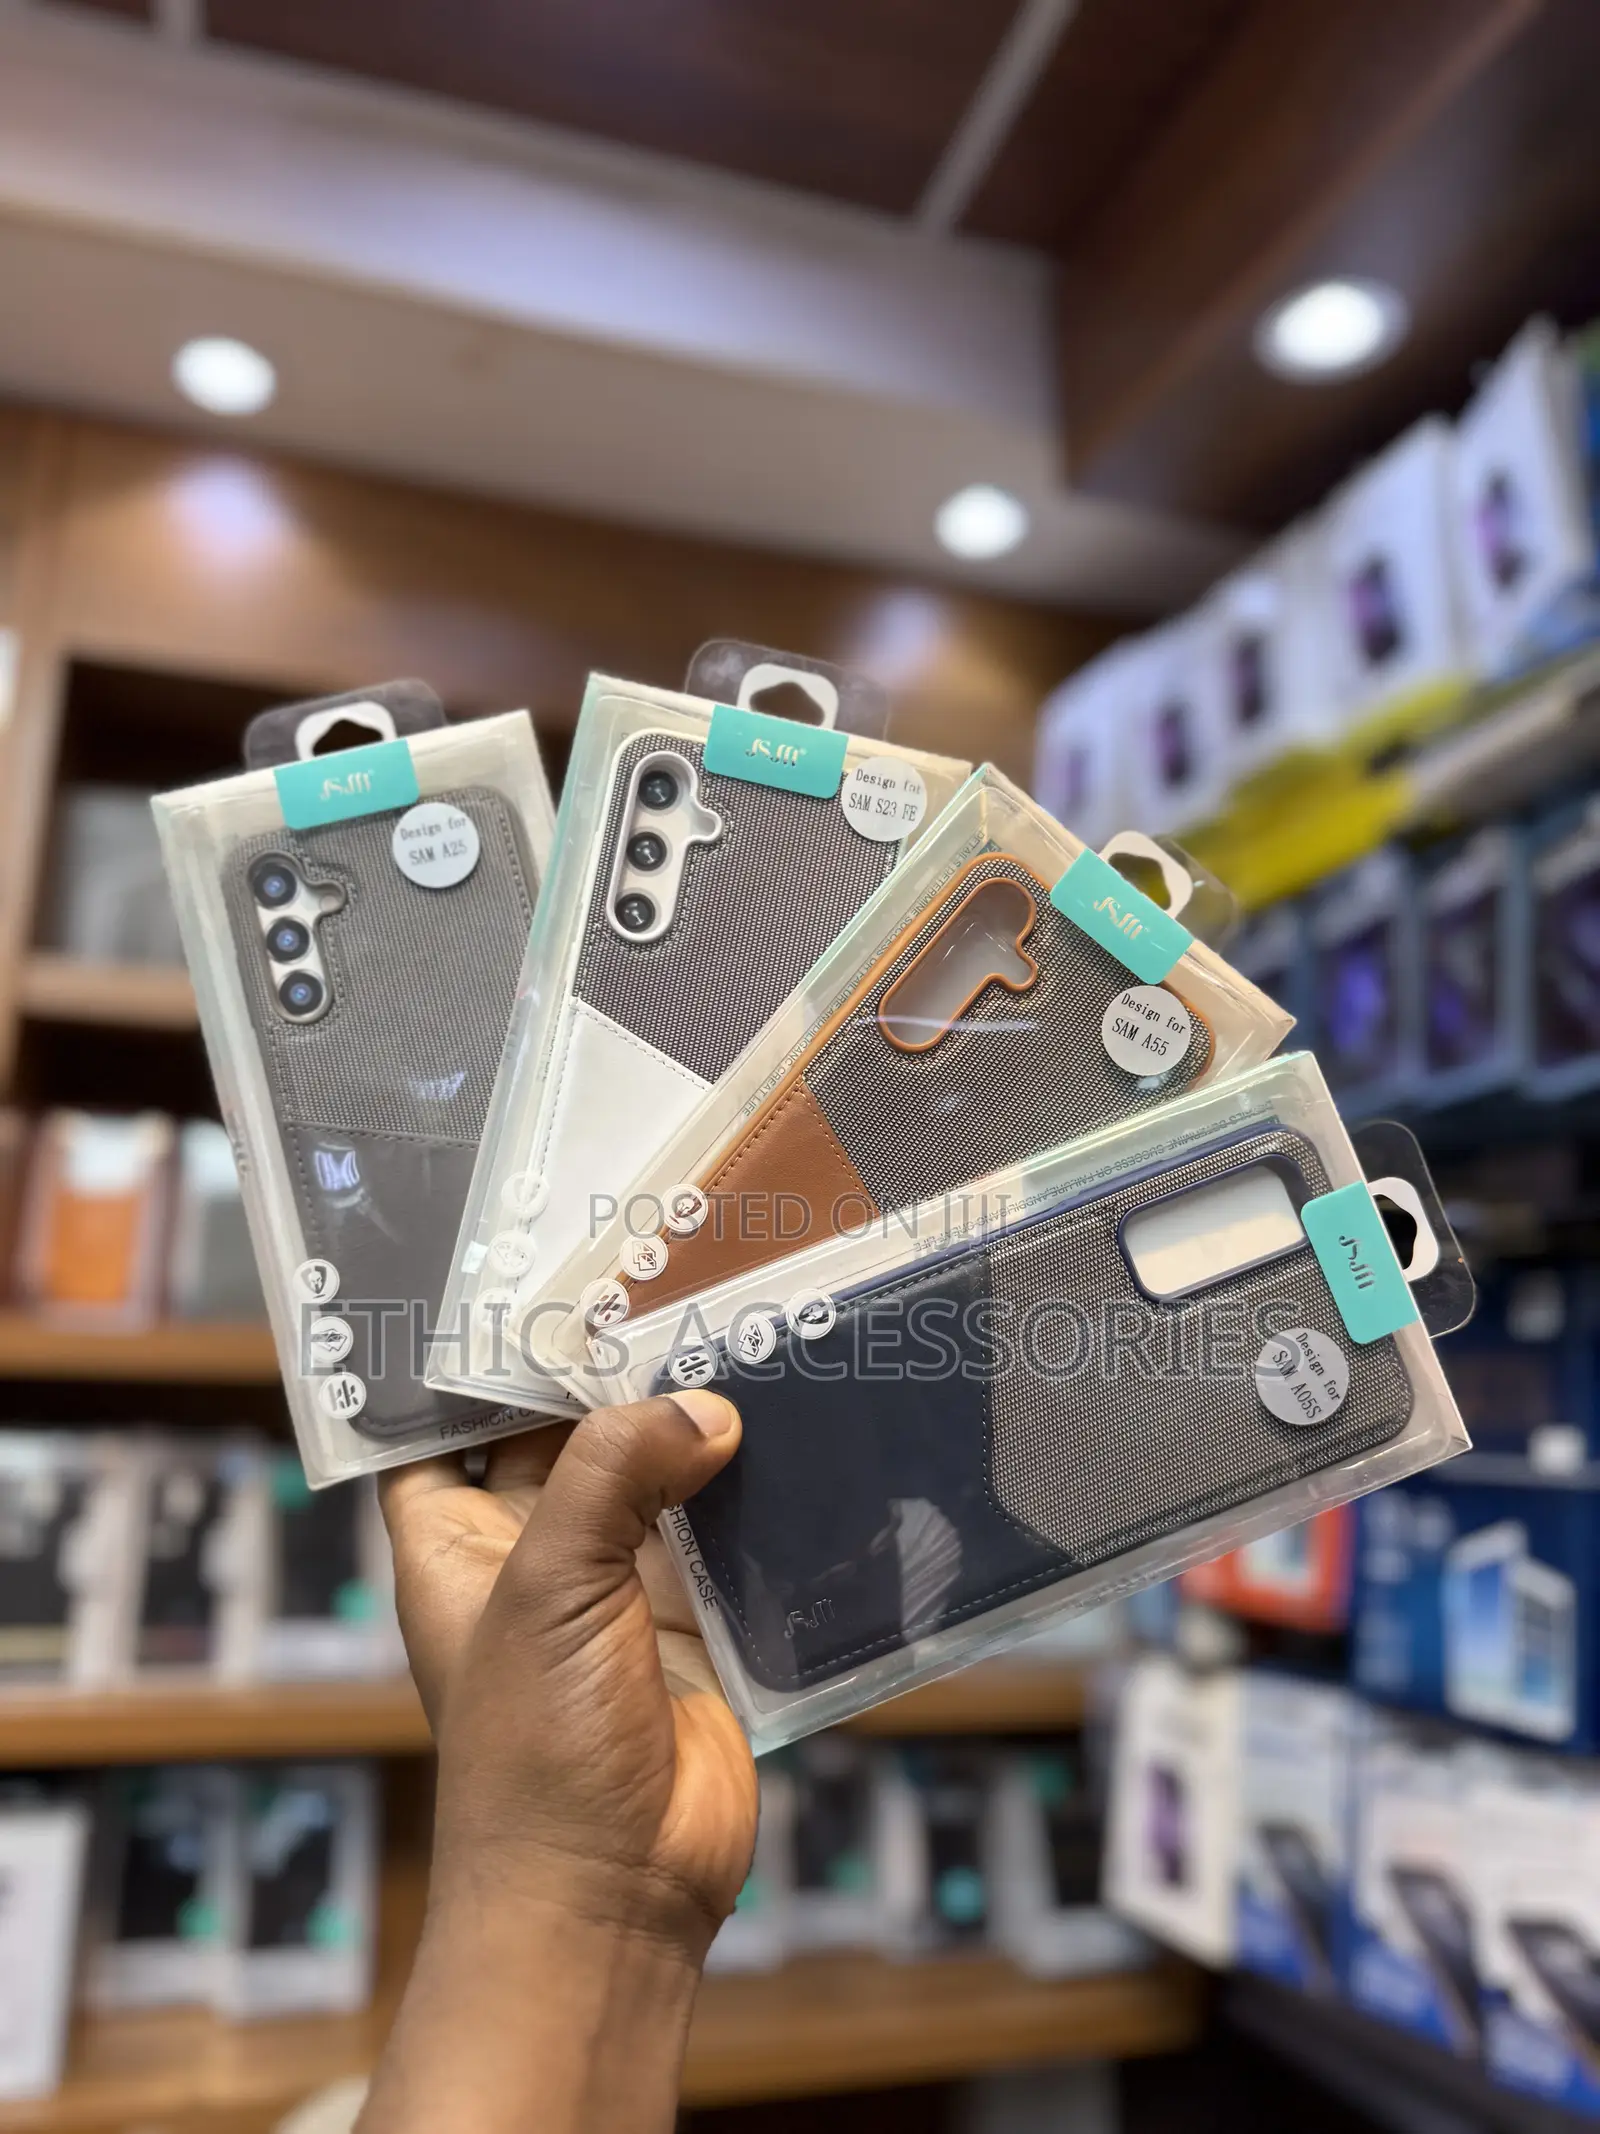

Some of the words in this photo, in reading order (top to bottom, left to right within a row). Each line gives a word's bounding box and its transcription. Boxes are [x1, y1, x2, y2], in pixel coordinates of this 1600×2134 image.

[856, 768, 896, 789] Design
[903, 778, 923, 794] for
[849, 792, 871, 814] SAM
[876, 797, 897, 817] S23
[901, 803, 918, 822] FE
[400, 822, 442, 842] Design
[448, 816, 467, 831] for
[409, 846, 436, 866] SAM
[442, 839, 468, 859] A25
[911, 866, 956, 916] DETERMINE
[1121, 993, 1161, 1022] Design
[1166, 1015, 1187, 1035] for
[1112, 1017, 1140, 1041] SAM
[1141, 1033, 1170, 1056] A55
[742, 1092, 762, 1117] LIFE
[1272, 1350, 1299, 1381] SAM
[1291, 1382, 1324, 1419] A05S
[1295, 1332, 1325, 1377] Design
[1323, 1379, 1341, 1402] for
[439, 1406, 514, 1440] FASHION
[690, 1560, 719, 1610] CASE
